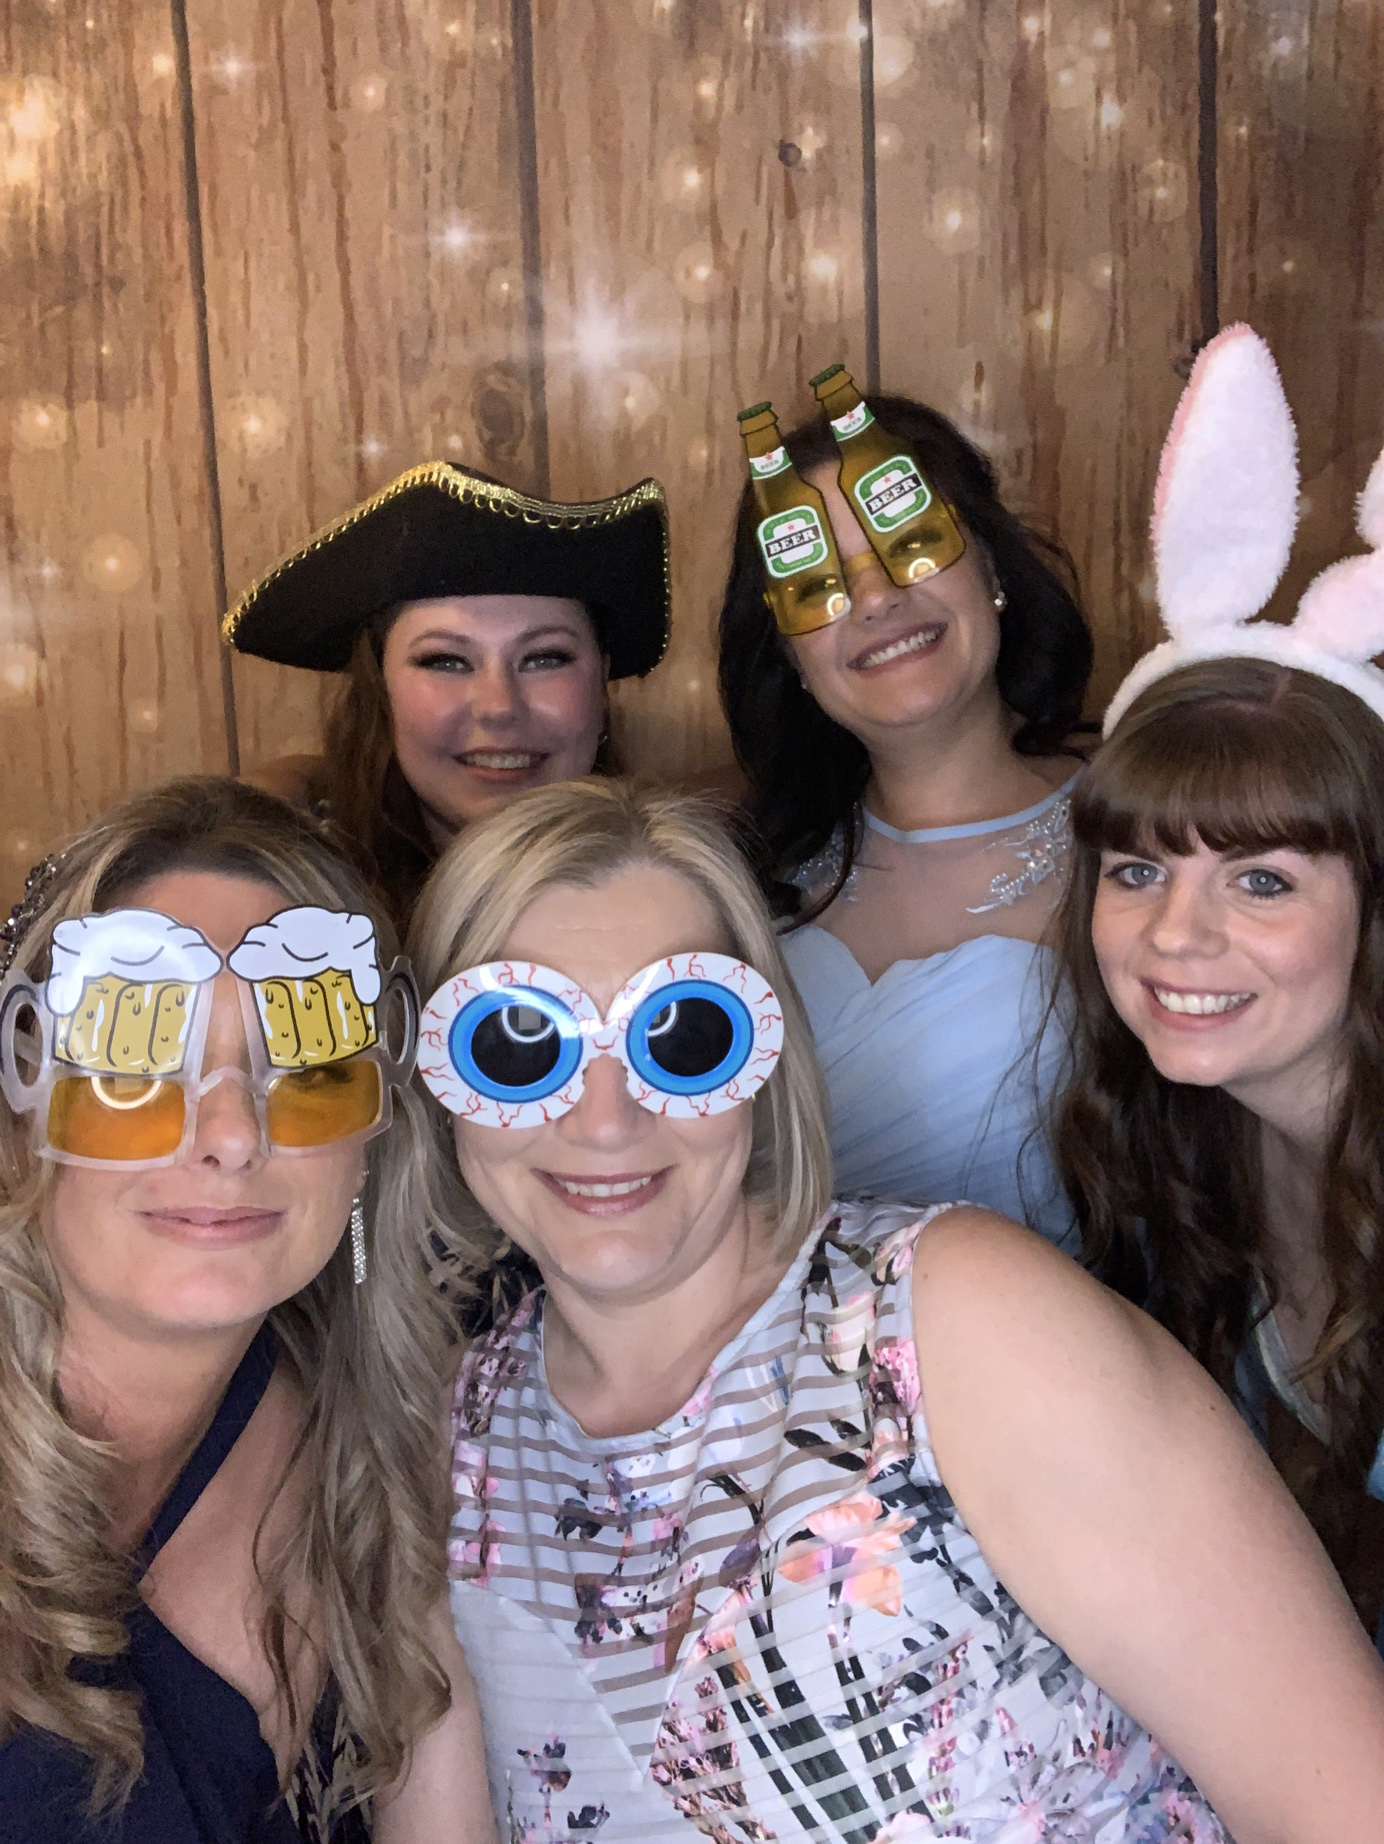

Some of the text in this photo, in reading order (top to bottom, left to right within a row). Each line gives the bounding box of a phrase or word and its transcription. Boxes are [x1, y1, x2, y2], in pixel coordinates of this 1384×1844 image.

[842, 416, 863, 431] BEER
[760, 459, 780, 471] BEER
[868, 477, 918, 513] BEER
[768, 529, 817, 555] BEER
